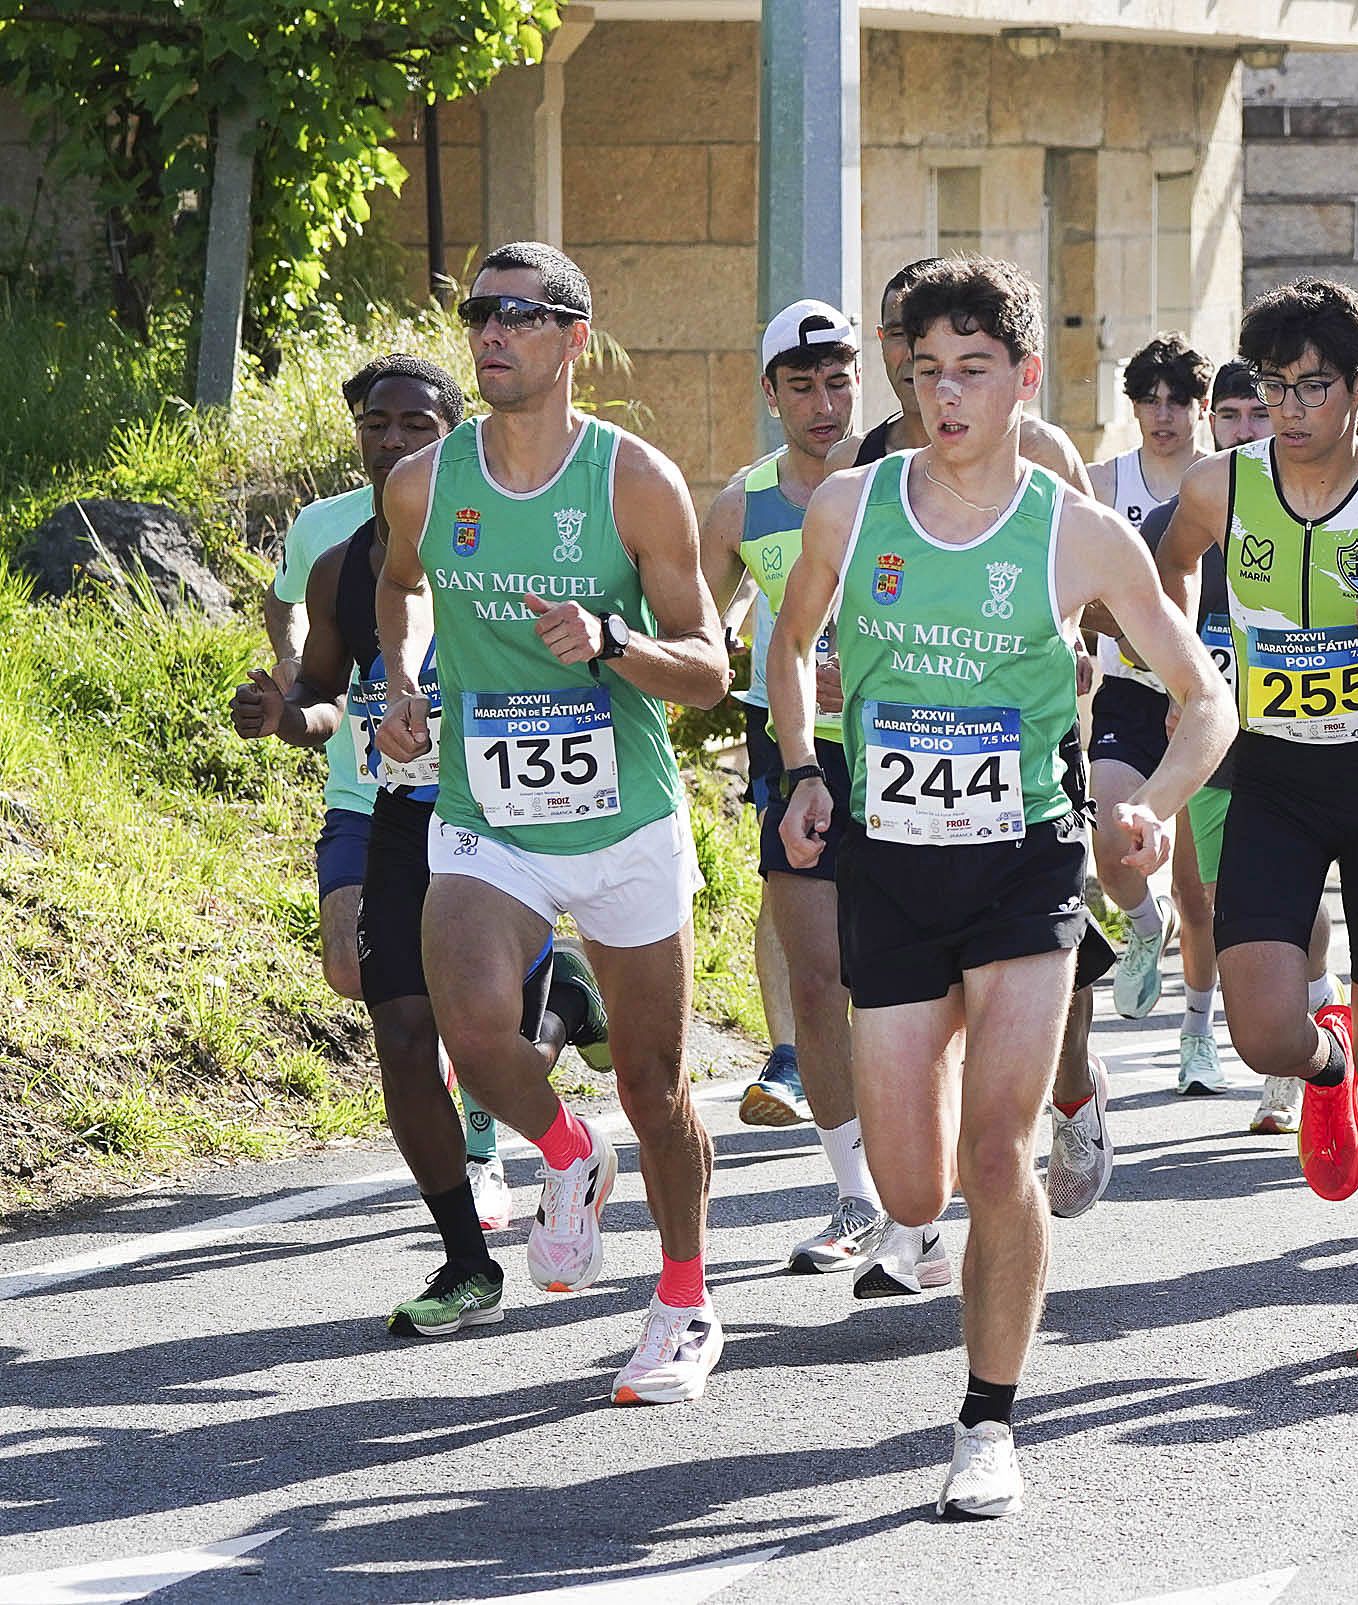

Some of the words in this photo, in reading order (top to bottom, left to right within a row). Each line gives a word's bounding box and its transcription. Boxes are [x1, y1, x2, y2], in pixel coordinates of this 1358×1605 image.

[435, 568, 485, 592] SAN
[491, 573, 606, 598] MIGUEL
[1240, 568, 1271, 583] MARÍN
[472, 601, 542, 621] MAR
[857, 615, 906, 643] SAN
[912, 623, 1028, 655] MIGUEL
[1285, 632, 1326, 642] XXXVII
[1256, 642, 1303, 654] MARATÓN
[891, 650, 987, 682] MARÍN
[1285, 655, 1326, 667] POIO
[508, 695, 551, 706] XXXVII
[474, 707, 527, 719] MARATÓN
[541, 702, 596, 717] FÁTIMA
[911, 709, 955, 722] XXXVII
[507, 720, 550, 733] POIO
[576, 715, 591, 725] 7.5
[594, 712, 611, 721] KM
[874, 718, 930, 734] MARATÓN
[930, 726, 943, 734] DE
[945, 721, 1003, 736] FÁTIMA
[1324, 722, 1346, 731] FROIZ
[909, 736, 953, 751] POIO
[981, 736, 998, 745] 7.5
[1001, 733, 1020, 743] KM
[483, 734, 598, 790] 135
[880, 752, 1009, 809] 244
[547, 797, 570, 806] FROIZ
[946, 818, 970, 828] FROIZ
